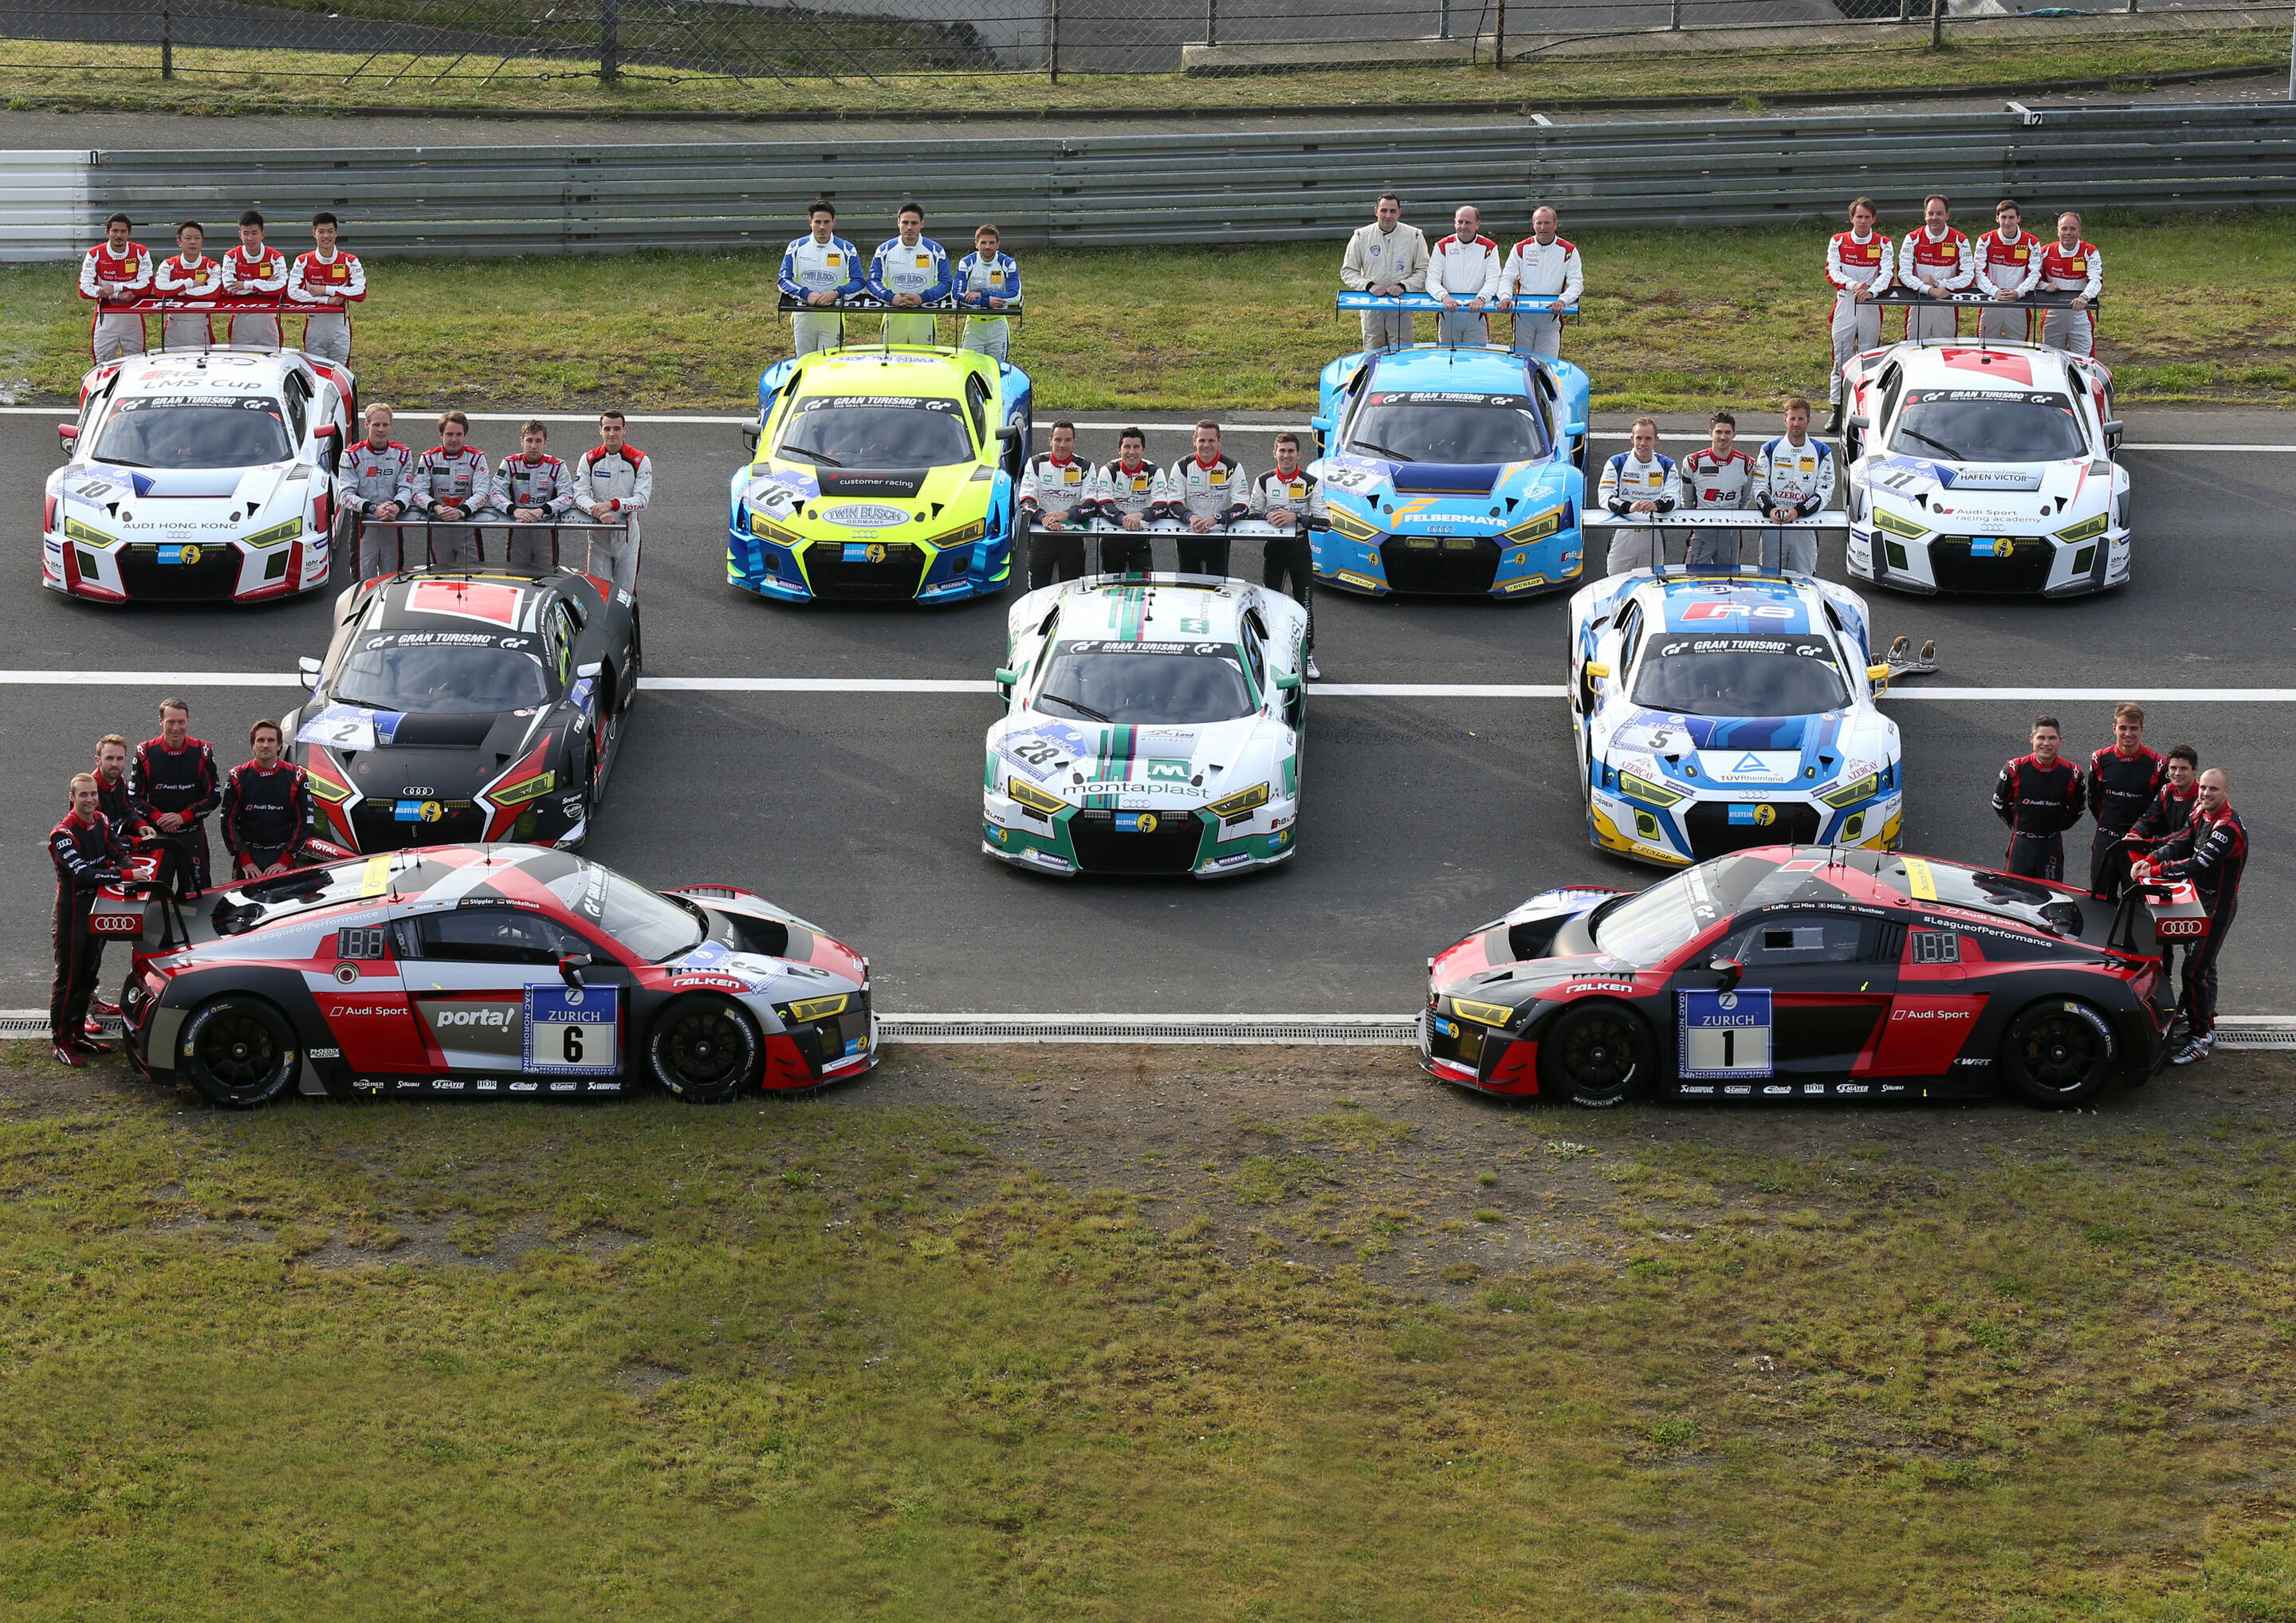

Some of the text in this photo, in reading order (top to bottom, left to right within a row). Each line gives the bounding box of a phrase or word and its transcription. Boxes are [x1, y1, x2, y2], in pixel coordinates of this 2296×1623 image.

[144, 379, 262, 391] LMS Cup
[151, 396, 236, 405] GRAN TURISMO
[867, 396, 918, 406] TURISMO
[1441, 392, 1485, 401] TURISMO
[1894, 465, 1933, 478] ZURICH
[1994, 474, 2027, 482] VICTOR
[95, 474, 128, 486] ZURICH
[885, 479, 914, 489] racing
[1327, 469, 1367, 488] 33
[1883, 472, 1917, 489] 11
[75, 480, 112, 499] 10
[776, 479, 811, 496] ZURICH
[755, 485, 794, 507] 16
[828, 506, 902, 521] TWIN BUSCH
[1985, 509, 2018, 518] Sport
[1404, 513, 1509, 529] FELBERMAYR
[1857, 549, 1869, 558] löhr
[1345, 575, 1374, 588] DUNLOP
[1512, 579, 1541, 590] DUNLOP
[1708, 604, 1795, 619] R8
[398, 634, 493, 643] GRAN TURISMO
[1693, 640, 1787, 650] GRAN TURISMO
[1102, 642, 1186, 652] GRAN TURISMO
[332, 723, 360, 742] 2
[1044, 733, 1078, 753] ZURICH
[1648, 730, 1673, 749] 5
[1012, 740, 1060, 765] 28
[1619, 760, 1659, 781] AZERÇAY
[1846, 760, 1879, 782] AZERÇAY
[1720, 774, 1783, 783] TÜVRheinland
[178, 783, 196, 792] Sport
[1063, 780, 1210, 800] montaplast
[1665, 781, 1693, 796] RAVENOL
[1813, 783, 1838, 797] RAVENOL
[989, 813, 1005, 823] LMS
[311, 839, 338, 856] TOTAL
[1640, 847, 1672, 859] DUNLOP
[1040, 854, 1069, 866] MICHELIN
[1218, 853, 1248, 865] MICHELIN
[505, 898, 541, 909] Winkelhock
[1771, 902, 1790, 911] Kaffer
[1858, 906, 1886, 916] Vanthoor
[291, 905, 351, 921] Audi Sport
[1961, 910, 2022, 929] Audi Sport
[248, 910, 379, 945] #LeagueofPerformance
[1923, 915, 2053, 949] #LeagueofPerformance
[673, 975, 741, 988] FALKEN
[1566, 983, 1634, 994] FALKEN
[345, 1006, 408, 1017] Audi Sport
[548, 1010, 600, 1022] ZURICH
[1907, 1010, 1970, 1021] Audi Sport
[187, 1010, 210, 1041] MICHELIN
[437, 1007, 516, 1034] porta!
[1702, 1015, 1755, 1026] ZURICH
[2080, 1006, 2109, 1035] MICHELIN
[735, 1016, 754, 1050] MICHELIN
[563, 1025, 584, 1063] 6
[1722, 1029, 1735, 1067] 1
[477, 1079, 497, 1090] HÖR
[509, 1082, 538, 1091] Eibach
[555, 1082, 576, 1091] Castrol
[1763, 1085, 1792, 1094] Eibach
[1804, 1083, 1824, 1093] HÖR
[1845, 1083, 1869, 1092] MAYER
